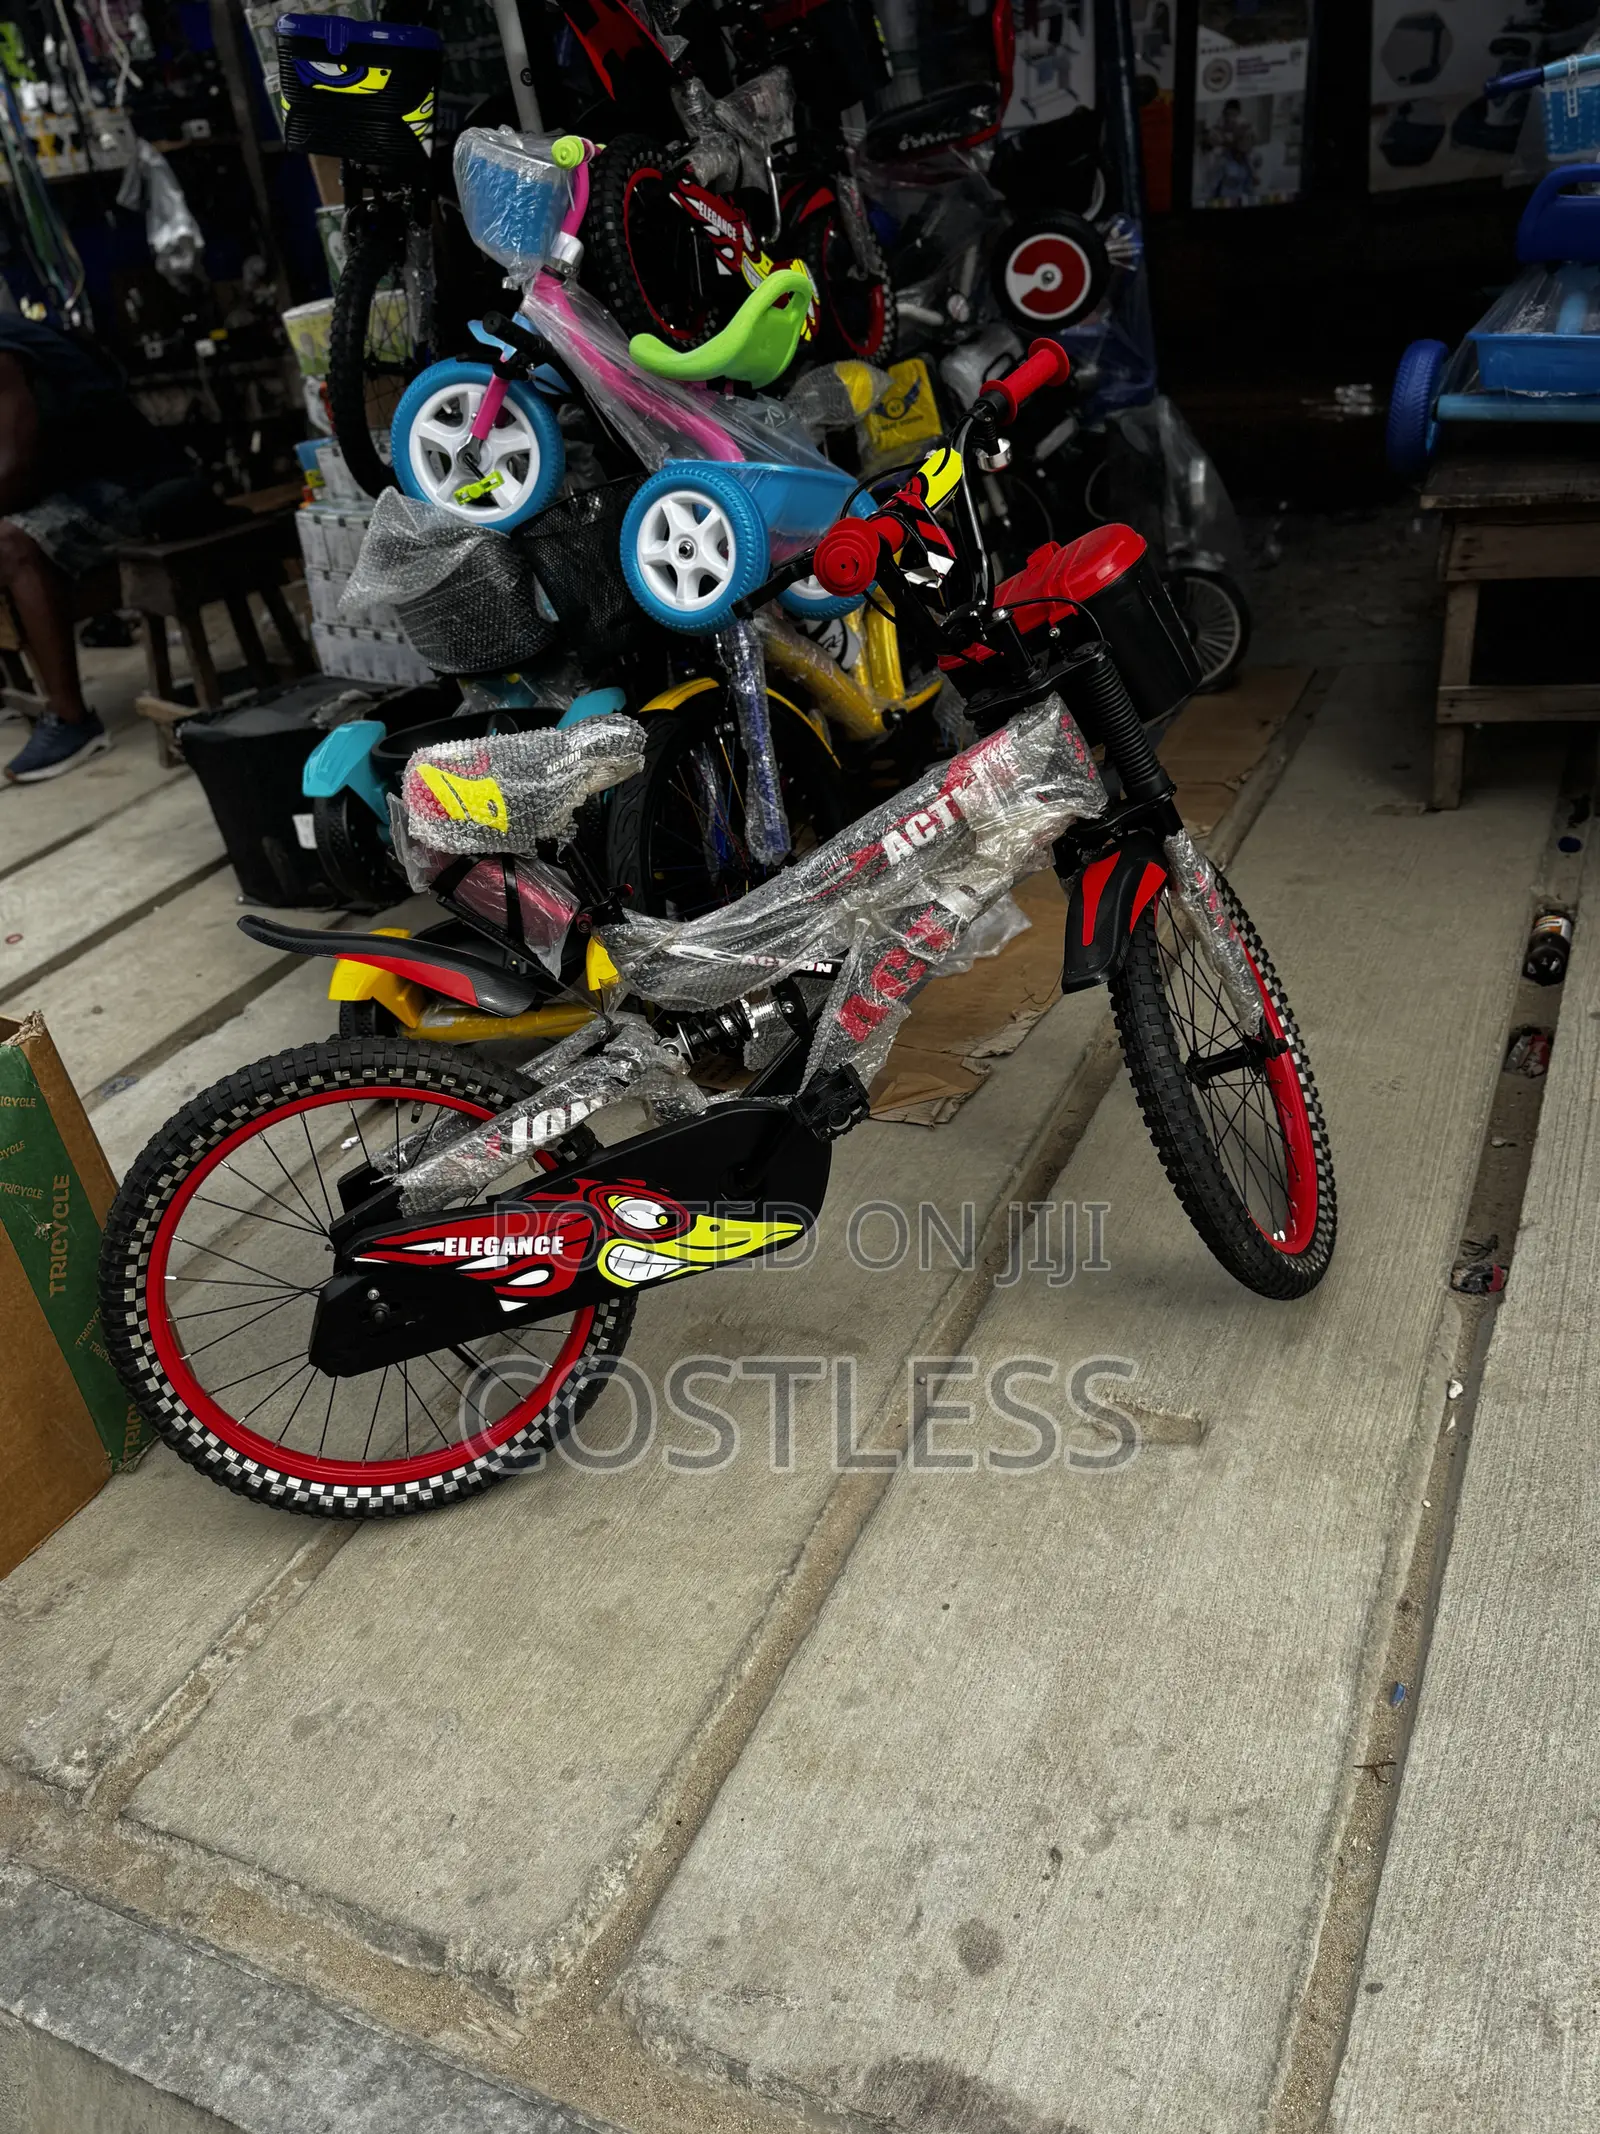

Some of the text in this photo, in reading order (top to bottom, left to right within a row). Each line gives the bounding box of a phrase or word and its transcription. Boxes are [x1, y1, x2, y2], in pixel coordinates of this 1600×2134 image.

[699, 200, 737, 242] ELEGANCE
[546, 749, 581, 775] ACTION
[49, 1174, 70, 1298] TRICYCLE
[444, 1236, 565, 1257] ELEGANCE
